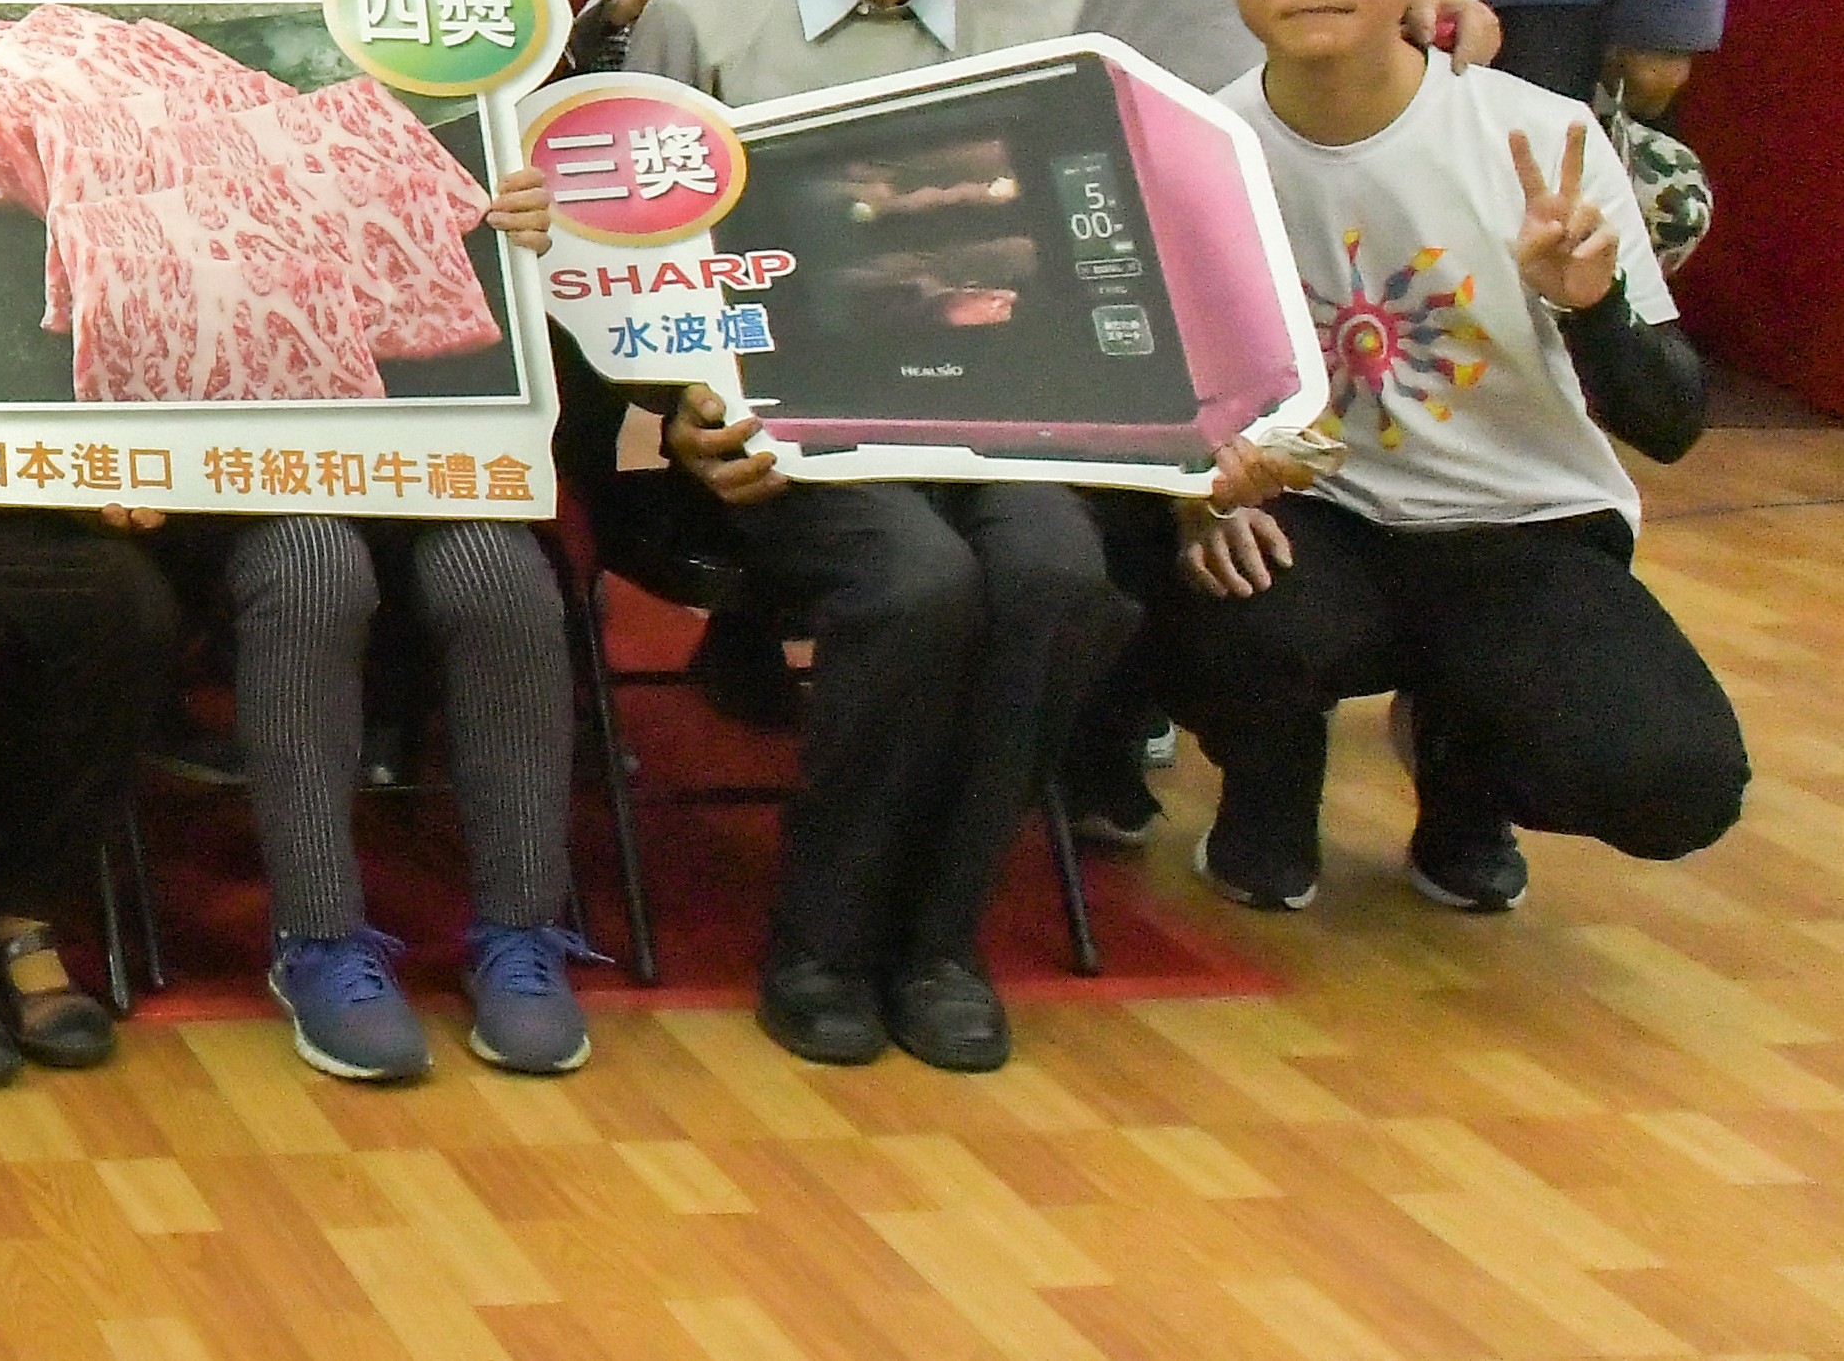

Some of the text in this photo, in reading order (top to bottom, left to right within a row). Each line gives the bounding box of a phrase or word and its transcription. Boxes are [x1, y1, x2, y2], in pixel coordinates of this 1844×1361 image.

[546, 123, 719, 204] 三獎
[549, 252, 794, 300] SHARP
[607, 306, 772, 360] 水波爐
[204, 446, 535, 504] 特級和牛禮盒
